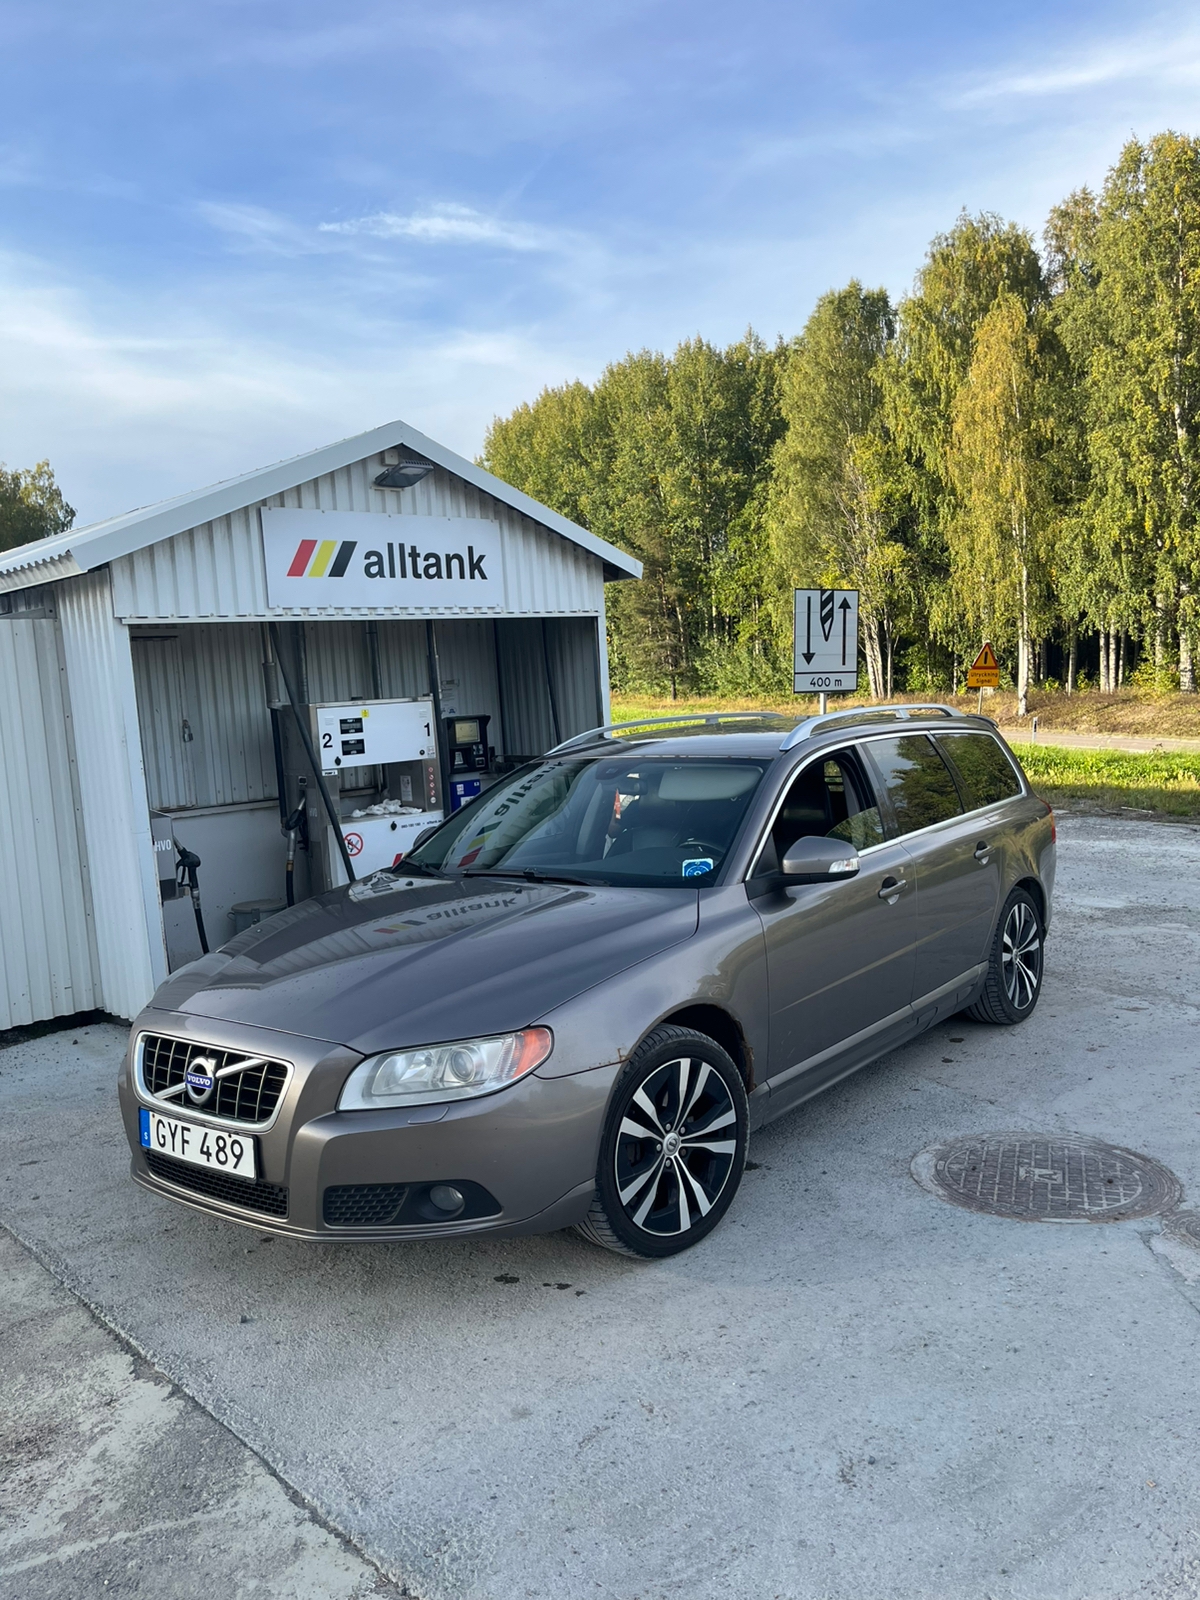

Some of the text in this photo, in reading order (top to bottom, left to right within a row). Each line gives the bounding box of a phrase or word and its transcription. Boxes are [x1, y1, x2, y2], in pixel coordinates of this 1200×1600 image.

[363, 542, 488, 580] alltank
[809, 677, 842, 688] 400 m
[424, 722, 430, 737] 1
[322, 733, 333, 748] 2
[153, 839, 172, 852] HVO
[187, 1074, 211, 1086] VOLVO
[144, 1132, 148, 1140] S
[156, 1118, 244, 1169] GYF 489
